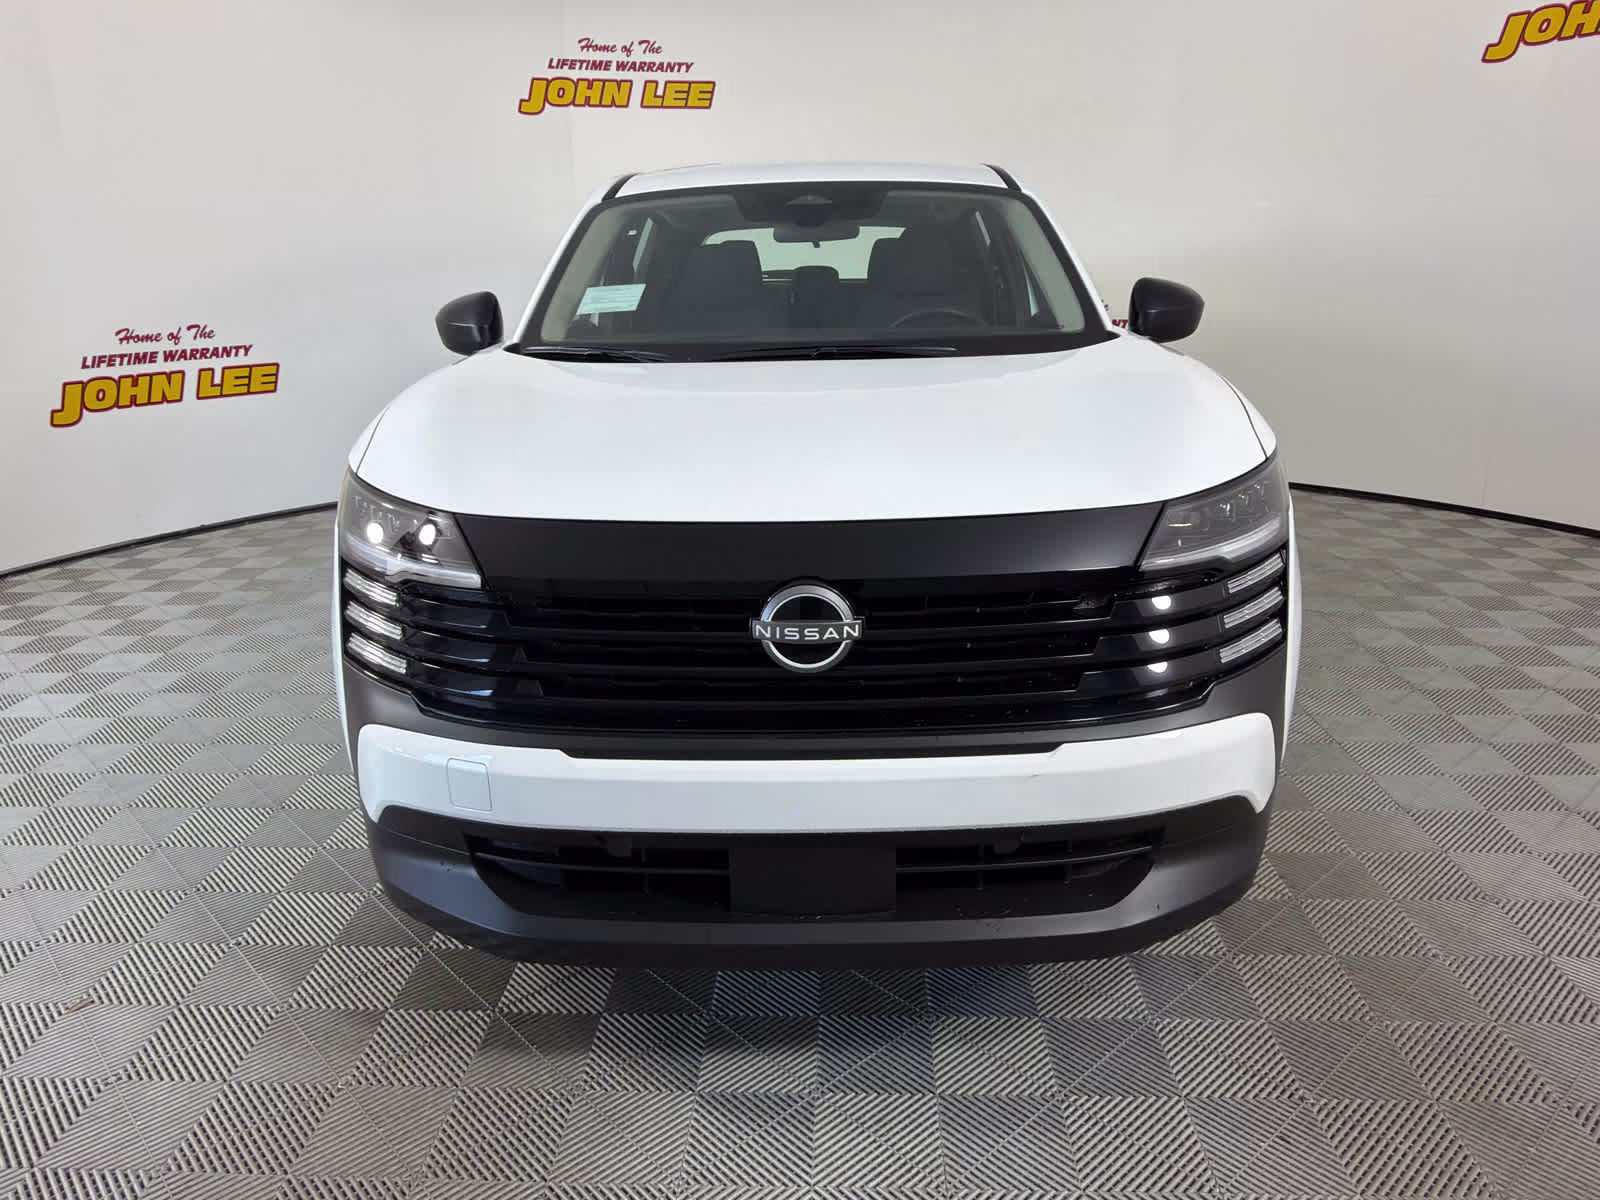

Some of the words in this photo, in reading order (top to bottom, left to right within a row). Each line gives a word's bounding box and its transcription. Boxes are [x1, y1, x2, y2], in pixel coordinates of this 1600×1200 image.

[1481, 0, 1600, 63] JOH
[577, 37, 618, 53] Home
[620, 41, 634, 57] of
[638, 39, 663, 54] The
[547, 58, 612, 71] LIFETIME
[615, 60, 694, 73] WARRANTY
[518, 76, 633, 115] JOHN
[640, 80, 715, 108] LEE
[115, 328, 163, 344] Home
[167, 327, 182, 345] of
[186, 324, 215, 341] The
[81, 351, 158, 369] LIFETIME
[162, 344, 253, 362] WARRANTY
[50, 370, 185, 427] JOHN
[196, 362, 280, 400] LEE
[755, 624, 859, 640] NISSAN
